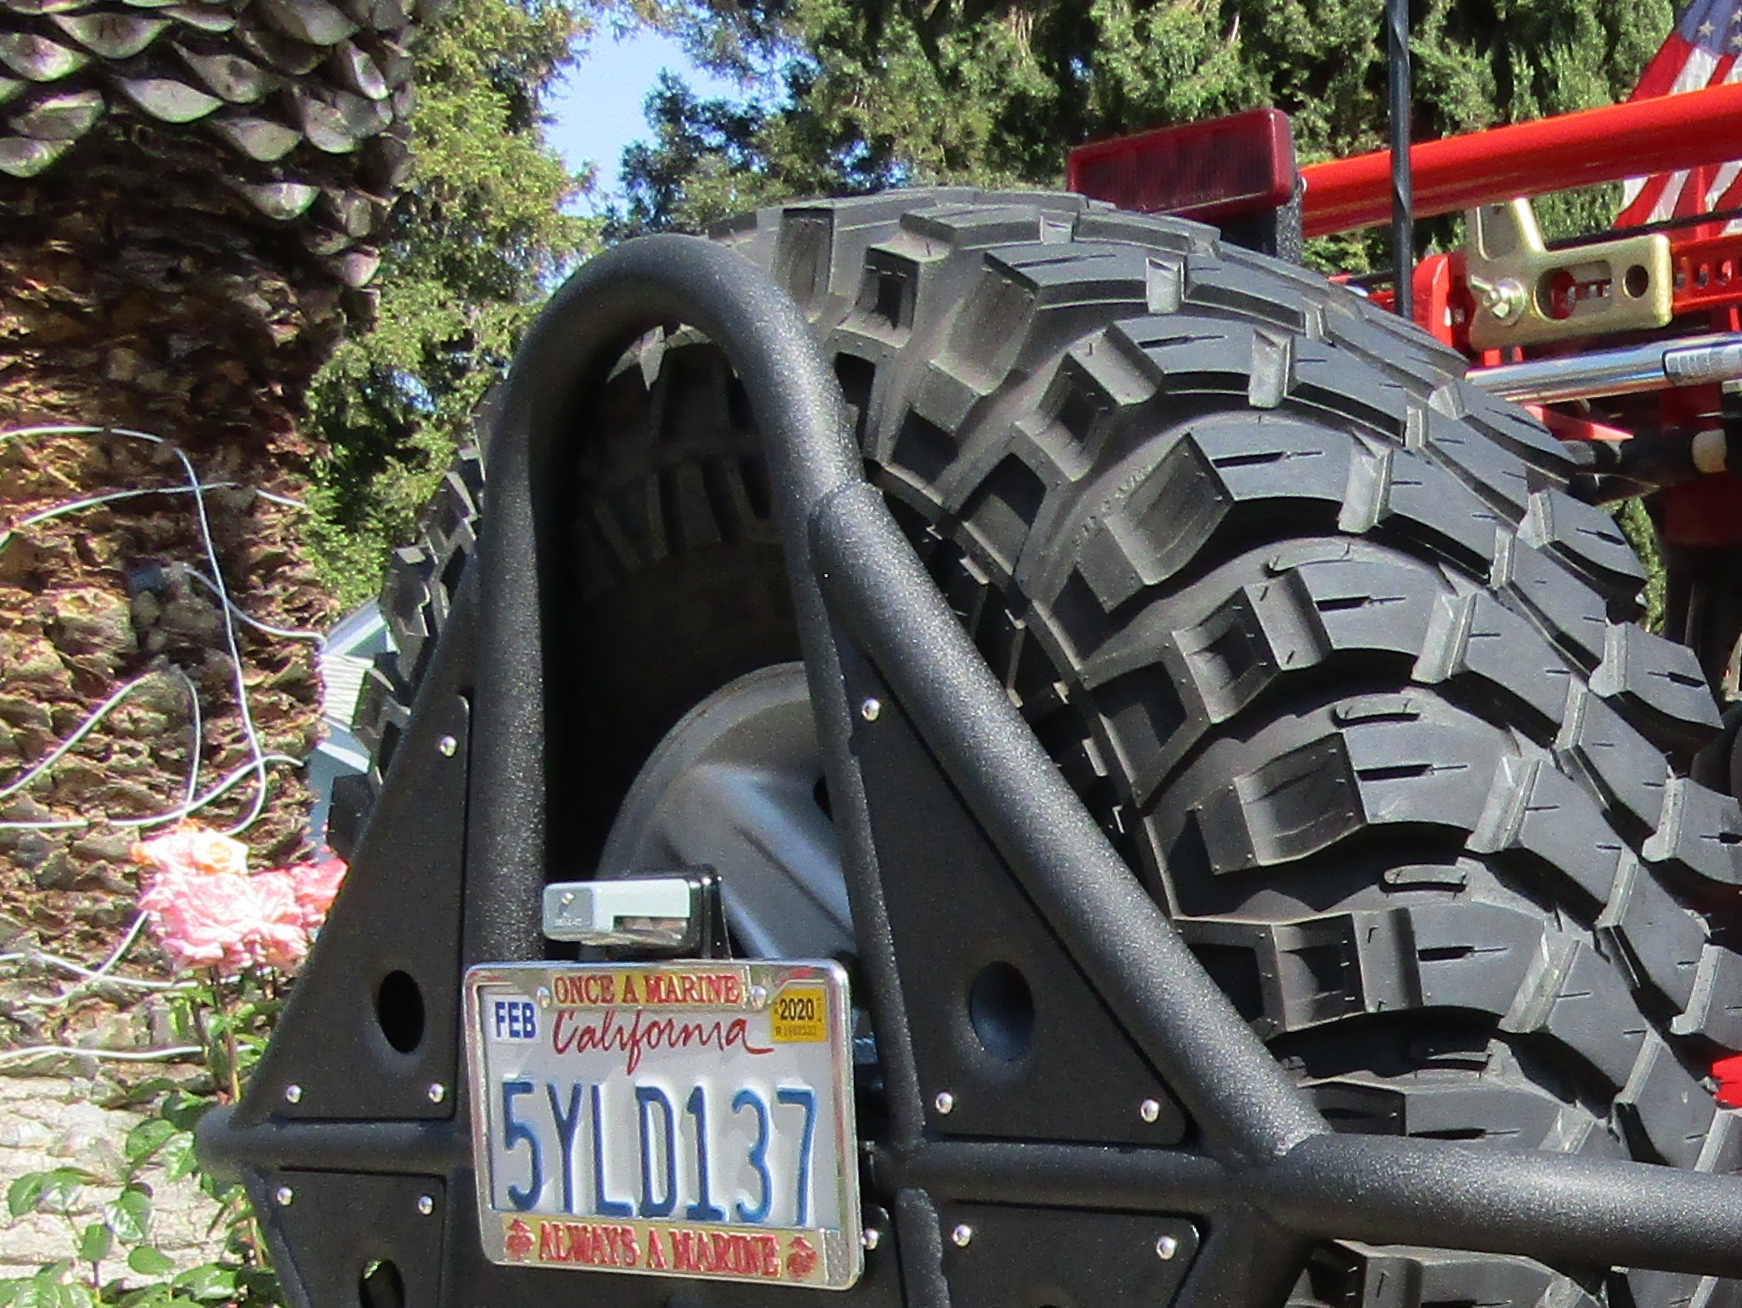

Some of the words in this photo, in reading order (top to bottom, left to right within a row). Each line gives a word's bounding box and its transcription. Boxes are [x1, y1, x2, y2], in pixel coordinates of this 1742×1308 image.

[553, 974, 615, 1005] ONCE
[622, 974, 642, 1004] A
[644, 972, 742, 1005] MARINE
[780, 997, 815, 1021] 2020
[495, 1001, 538, 1039] FEB
[553, 1009, 774, 1076] California
[503, 1081, 817, 1227] 5YLD137
[538, 1220, 641, 1267] ALWAYS
[645, 1227, 667, 1269] A
[669, 1228, 782, 1279] MARINE
